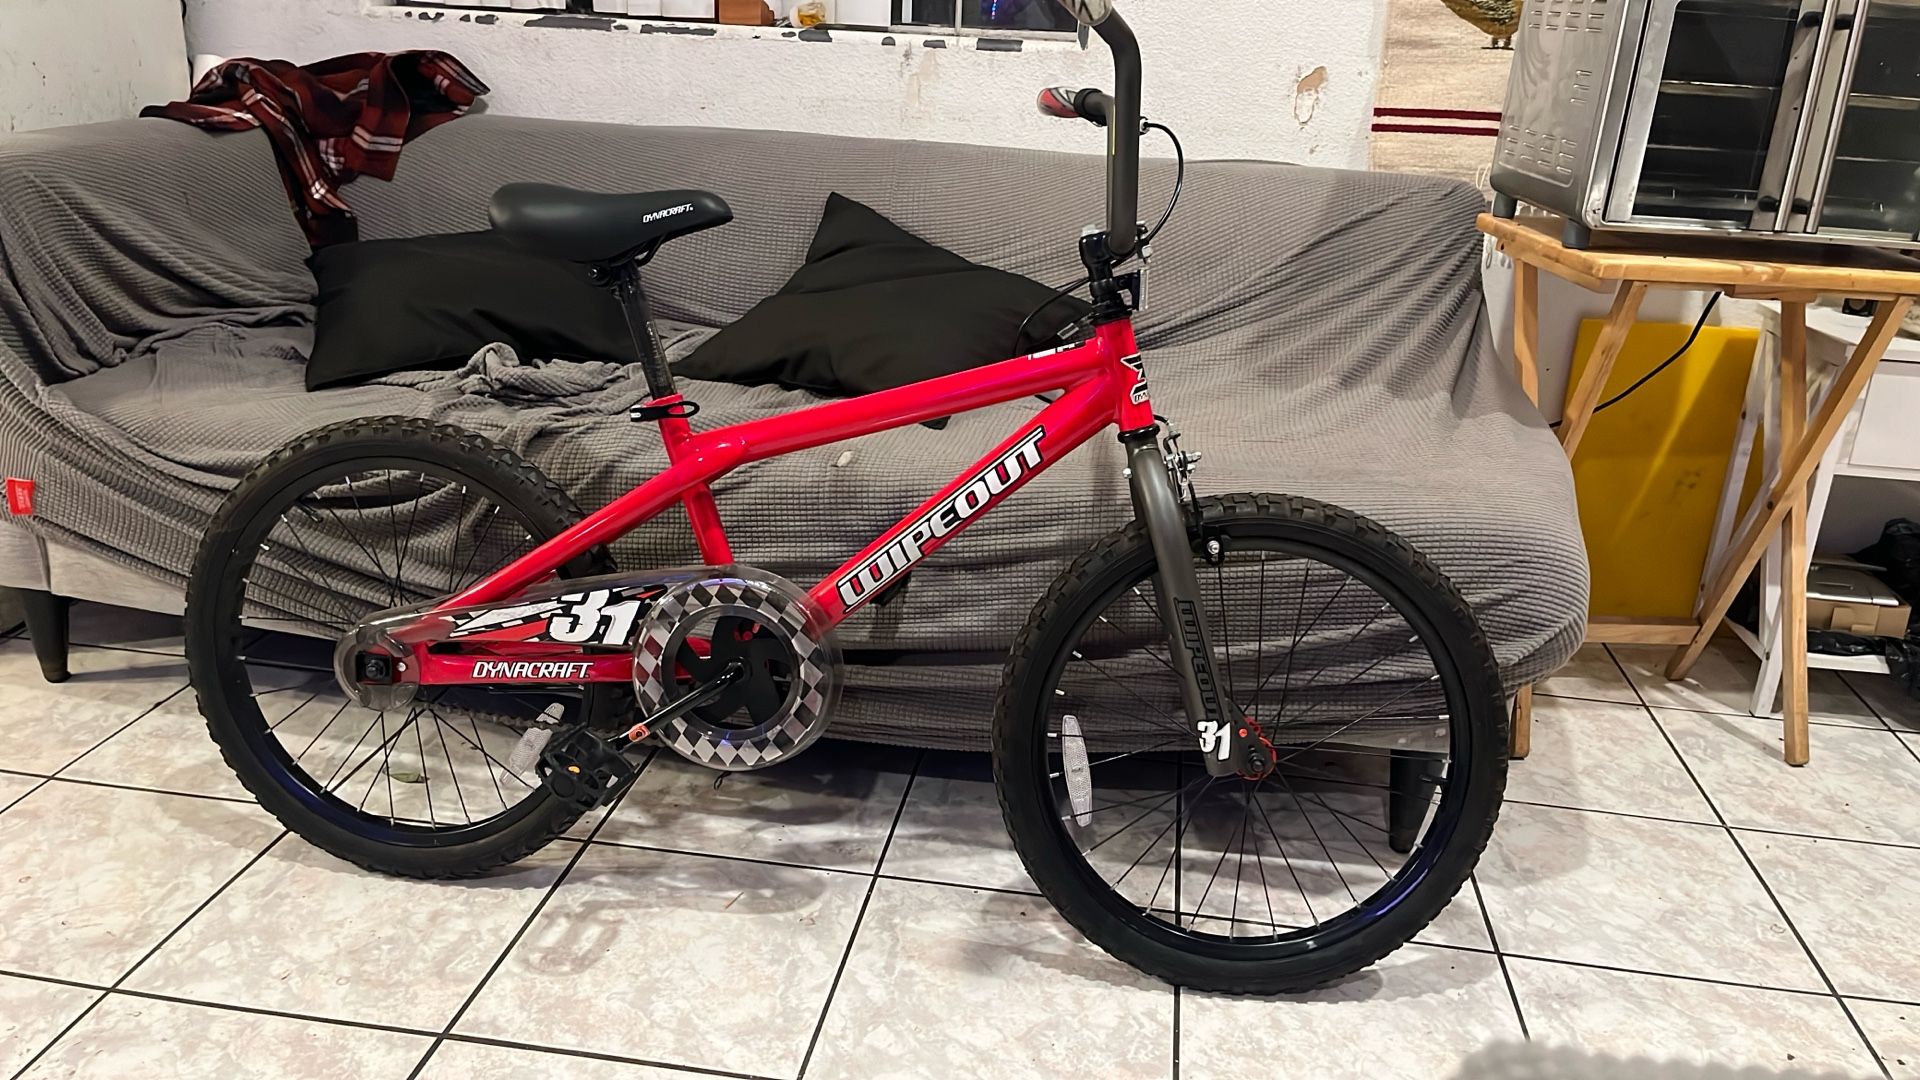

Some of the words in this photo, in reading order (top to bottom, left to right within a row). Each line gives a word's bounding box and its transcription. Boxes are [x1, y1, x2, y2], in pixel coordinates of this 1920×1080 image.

[837, 426, 1046, 613] WIPEOUT
[549, 588, 642, 645] 31
[472, 661, 594, 679] DYNACRAFT
[1197, 720, 1231, 761] 31
